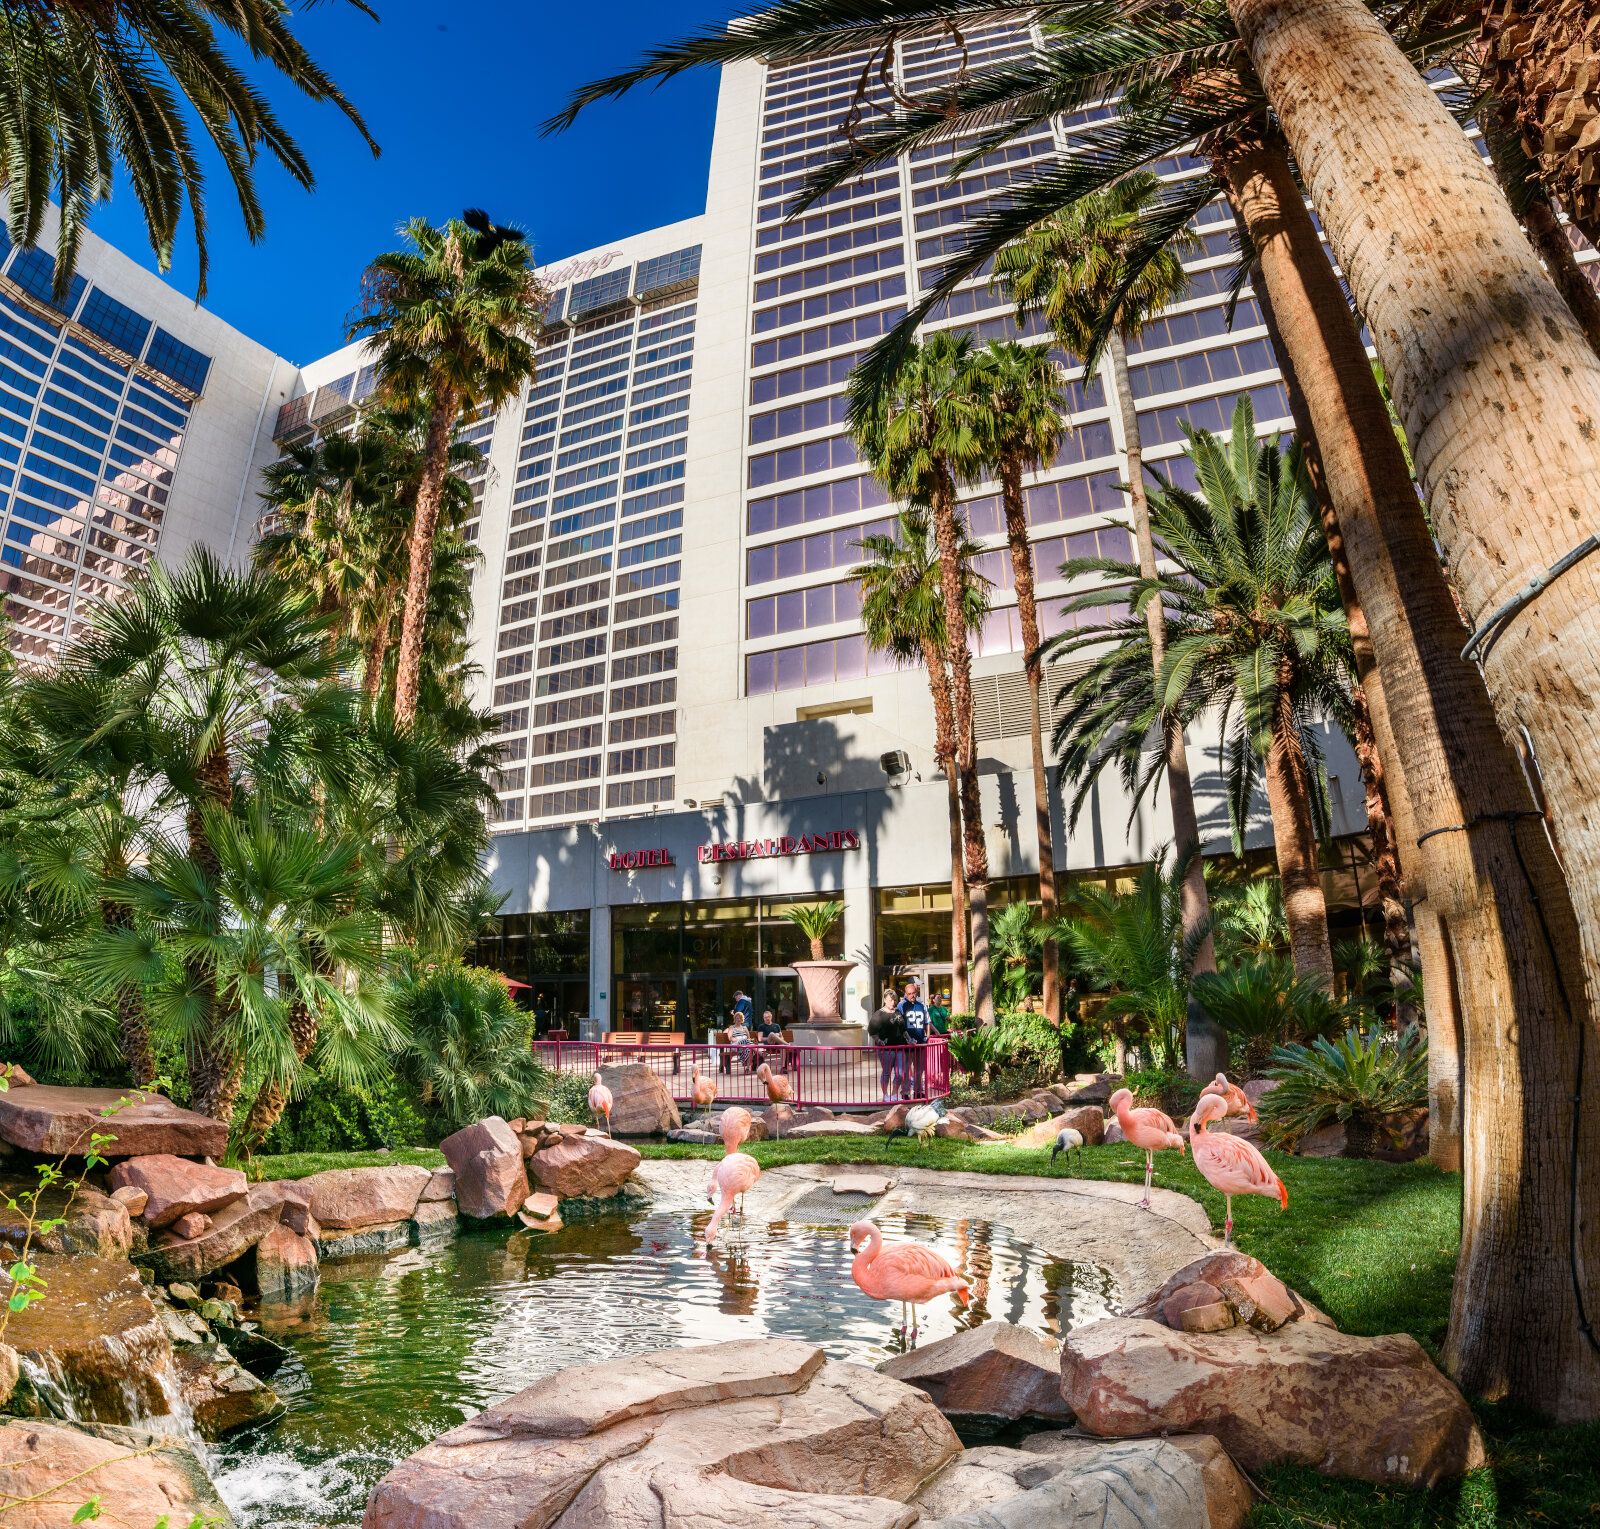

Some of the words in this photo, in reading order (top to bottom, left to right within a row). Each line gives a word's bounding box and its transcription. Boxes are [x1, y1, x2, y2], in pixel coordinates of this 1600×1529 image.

[609, 848, 673, 869] HOTEL
[697, 829, 859, 862] RESTAURANTS
[906, 1010, 925, 1029] 22
